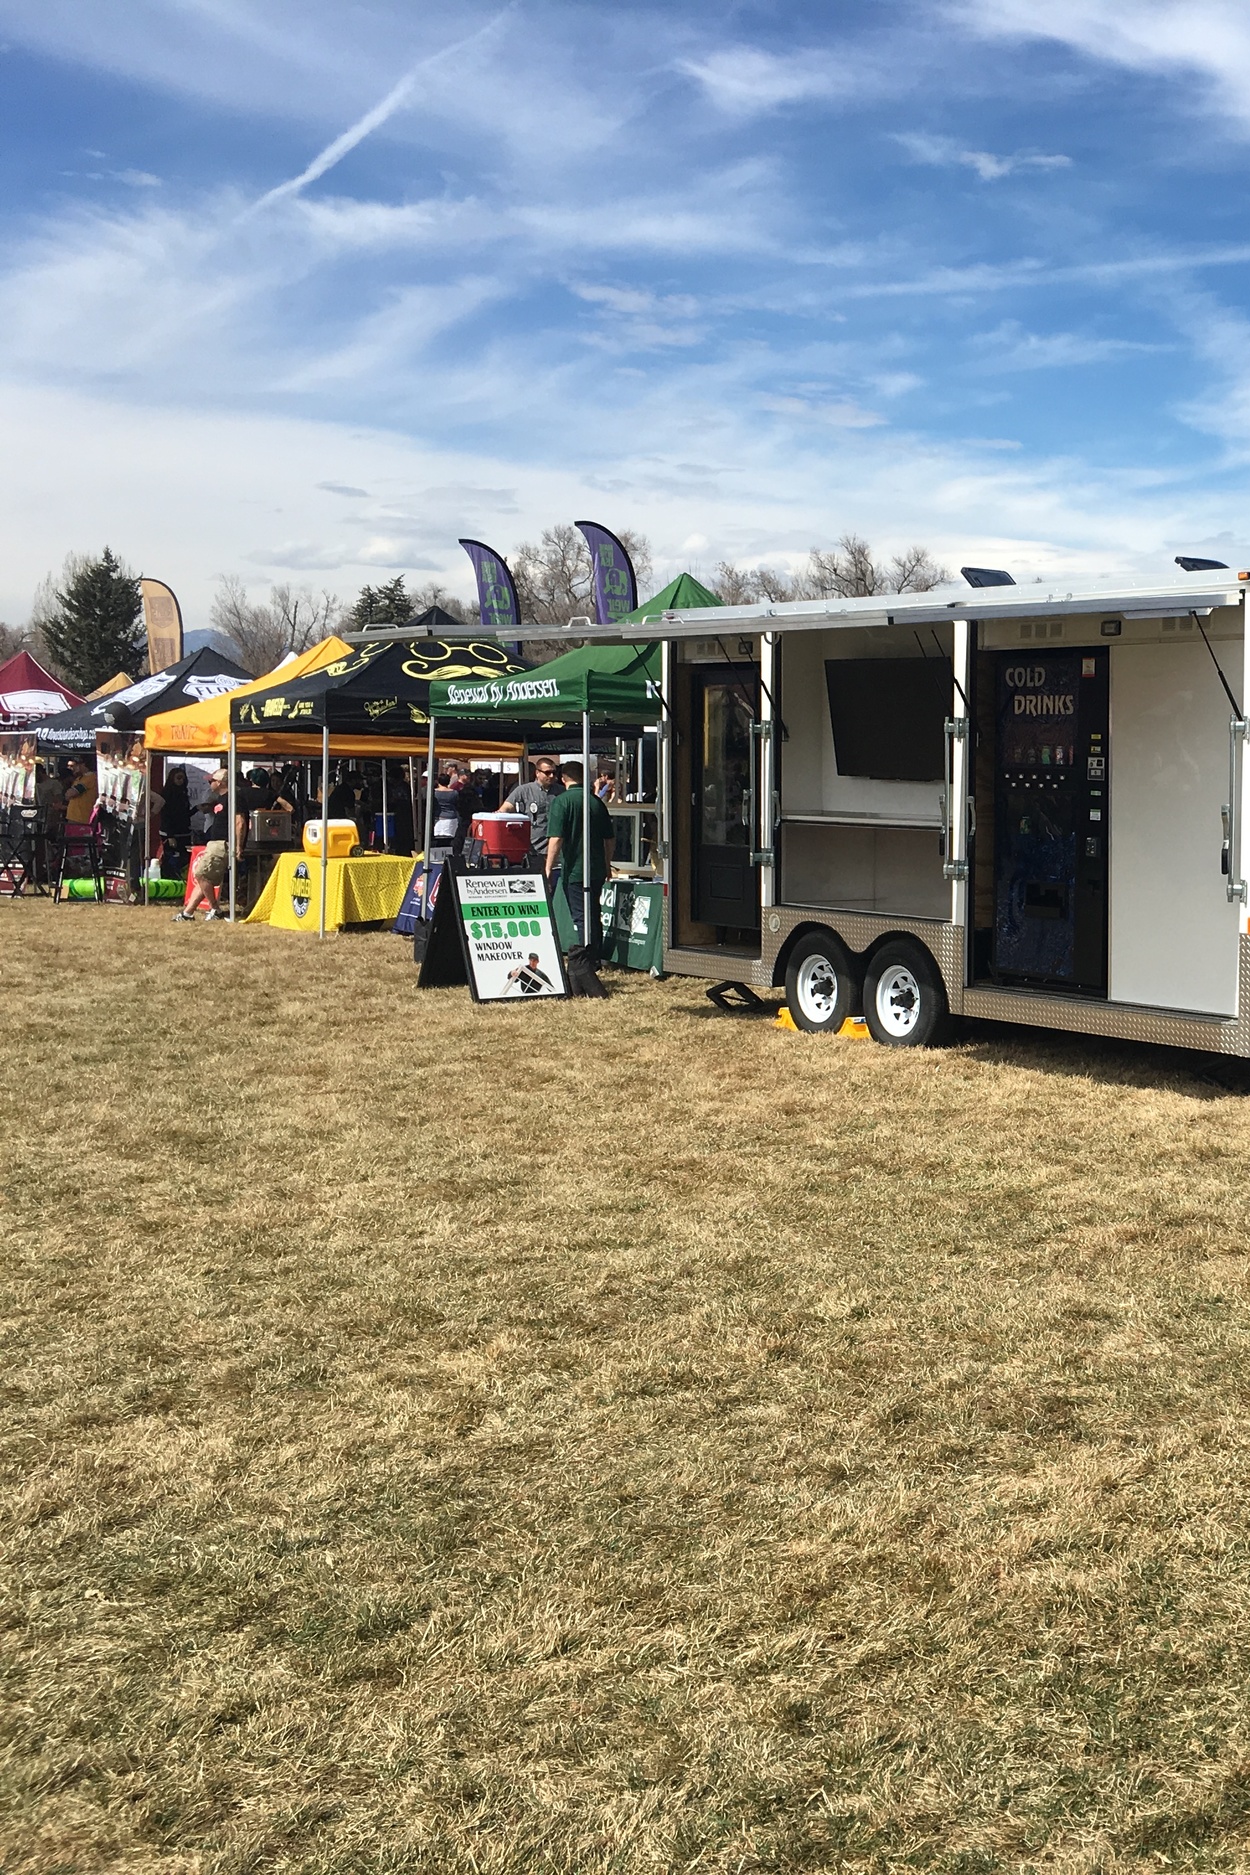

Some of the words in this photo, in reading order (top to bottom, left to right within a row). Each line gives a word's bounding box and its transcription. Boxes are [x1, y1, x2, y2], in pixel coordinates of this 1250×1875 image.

[1005, 667, 1046, 687] COLD
[446, 682, 488, 705] Renewal
[490, 681, 503, 708] by
[1014, 695, 1074, 716] DRINKS
[465, 879, 506, 889] Renewal
[471, 905, 501, 917] ENTER
[502, 905, 515, 916] TO
[518, 904, 540, 915] WIN!
[470, 920, 541, 940] $15,000
[475, 942, 513, 951] WINDOW
[477, 951, 524, 962] MAKEOVER
